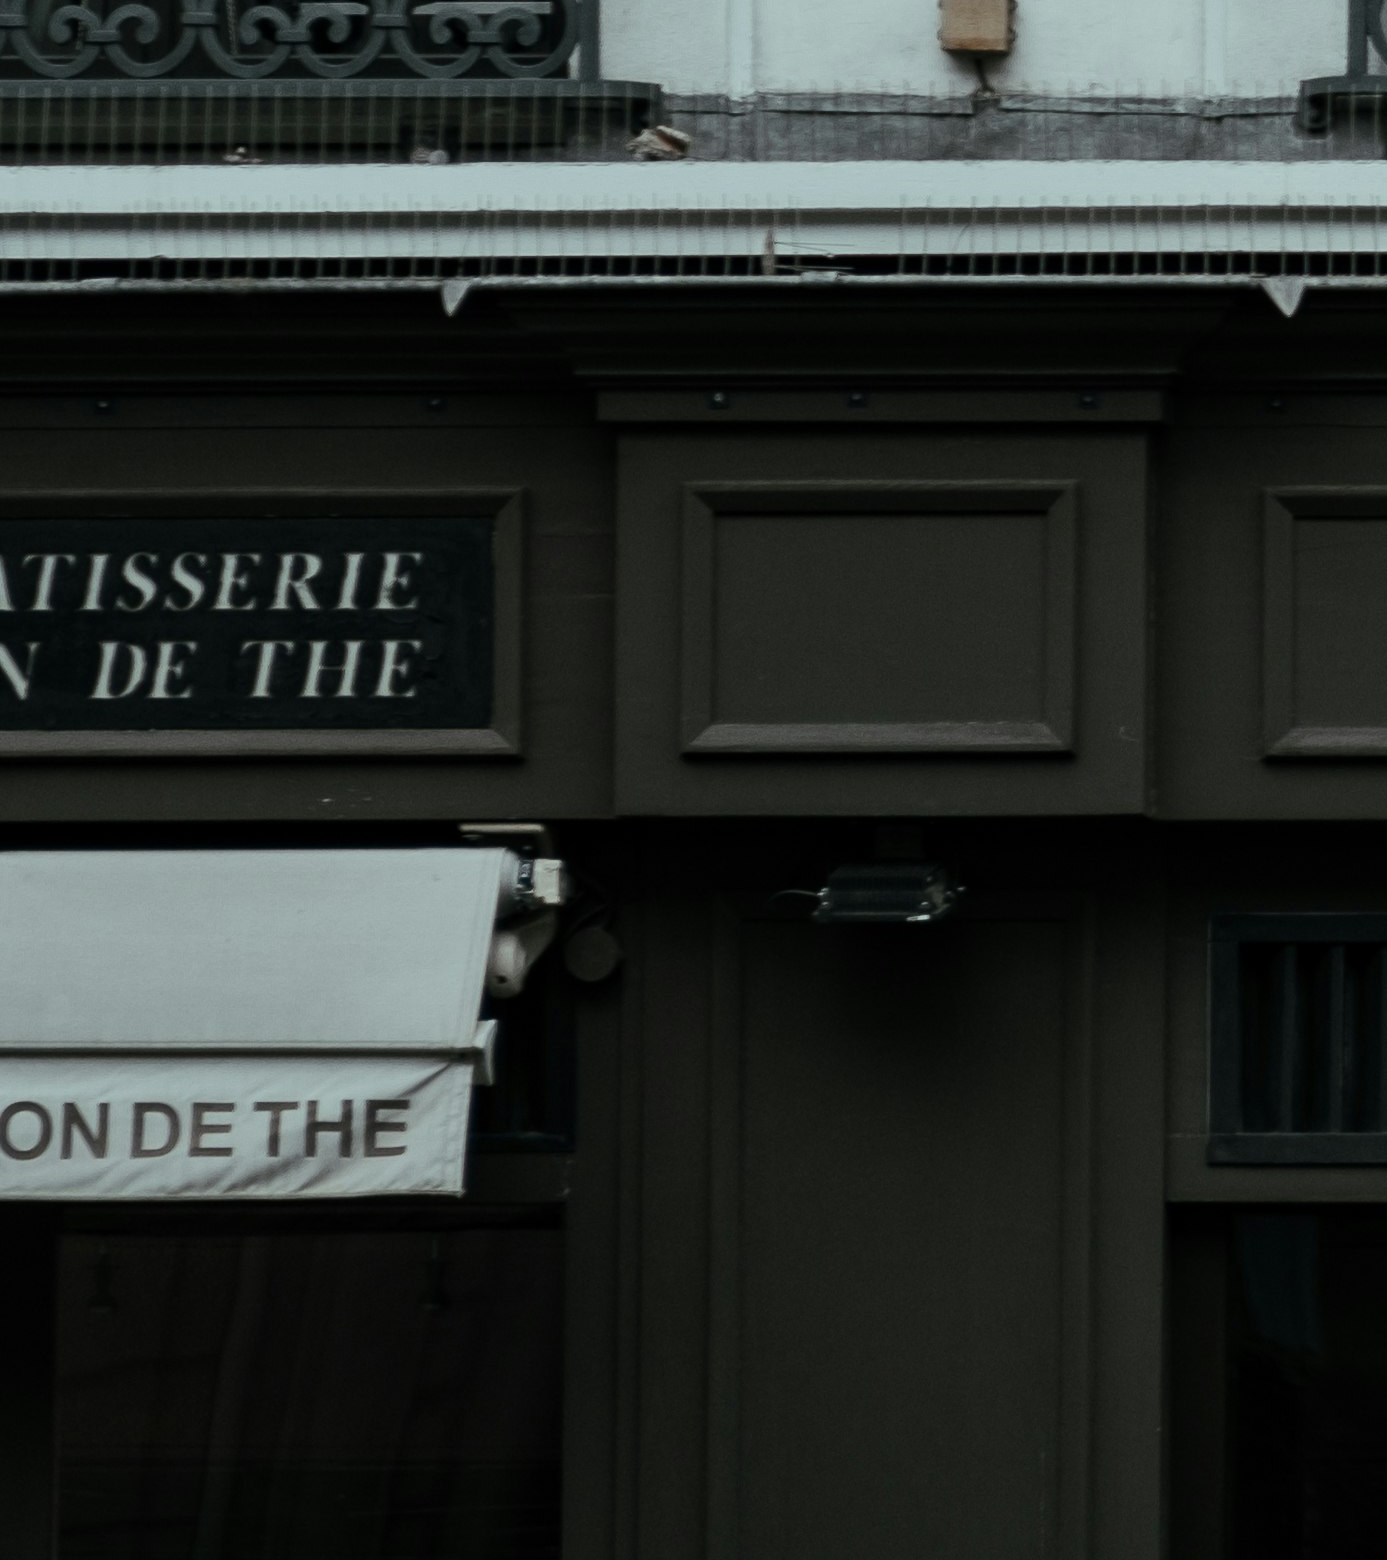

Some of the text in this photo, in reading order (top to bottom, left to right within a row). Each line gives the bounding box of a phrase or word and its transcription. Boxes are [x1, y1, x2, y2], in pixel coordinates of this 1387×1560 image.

[88, 640, 198, 699] DE
[239, 639, 424, 699] THE
[0, 1099, 411, 1160] ON DE THE
